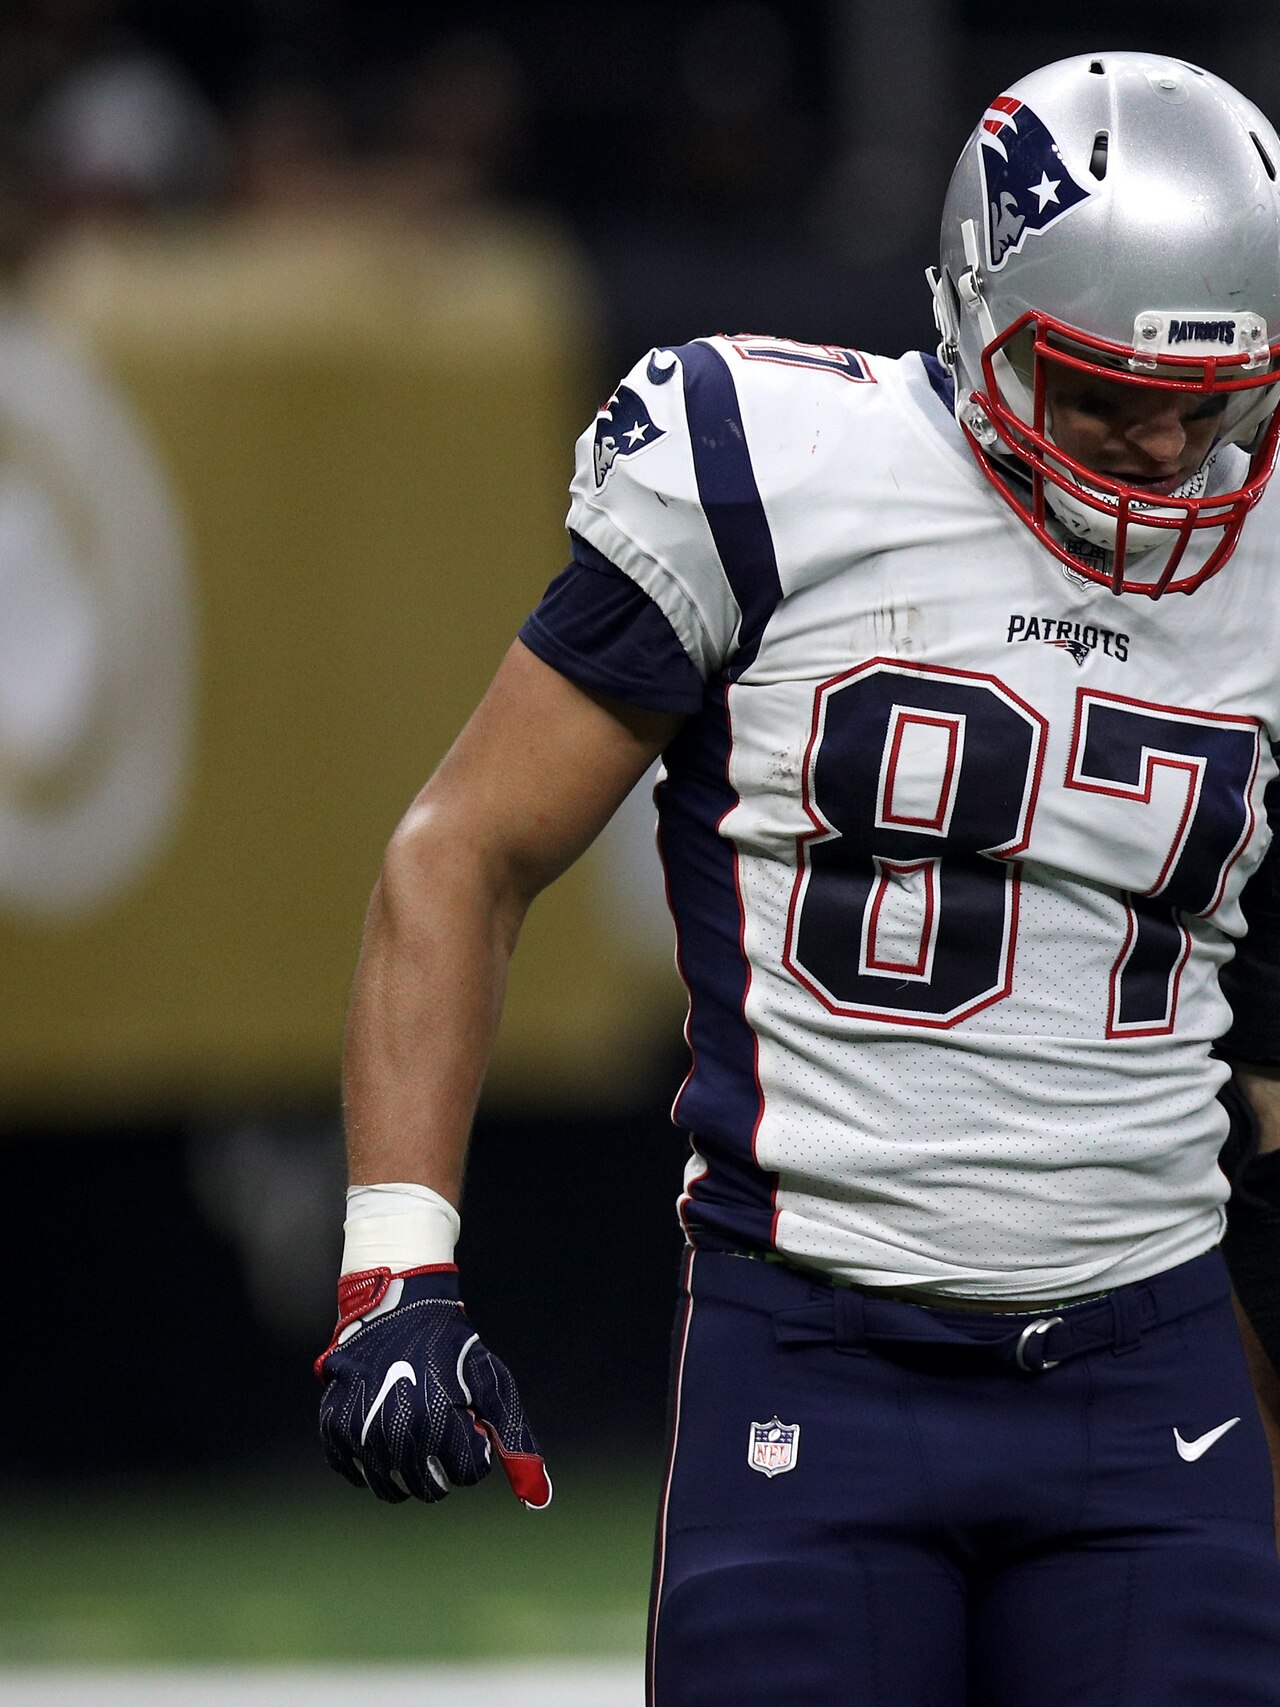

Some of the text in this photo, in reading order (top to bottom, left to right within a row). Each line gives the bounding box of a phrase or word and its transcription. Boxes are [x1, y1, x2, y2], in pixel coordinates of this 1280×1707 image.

[1168, 320, 1236, 345] PATRIOTS
[716, 332, 878, 383] 7
[1006, 615, 1130, 662] PATRIOTS
[782, 656, 1261, 1038] 87
[756, 1444, 789, 1467] NFL
